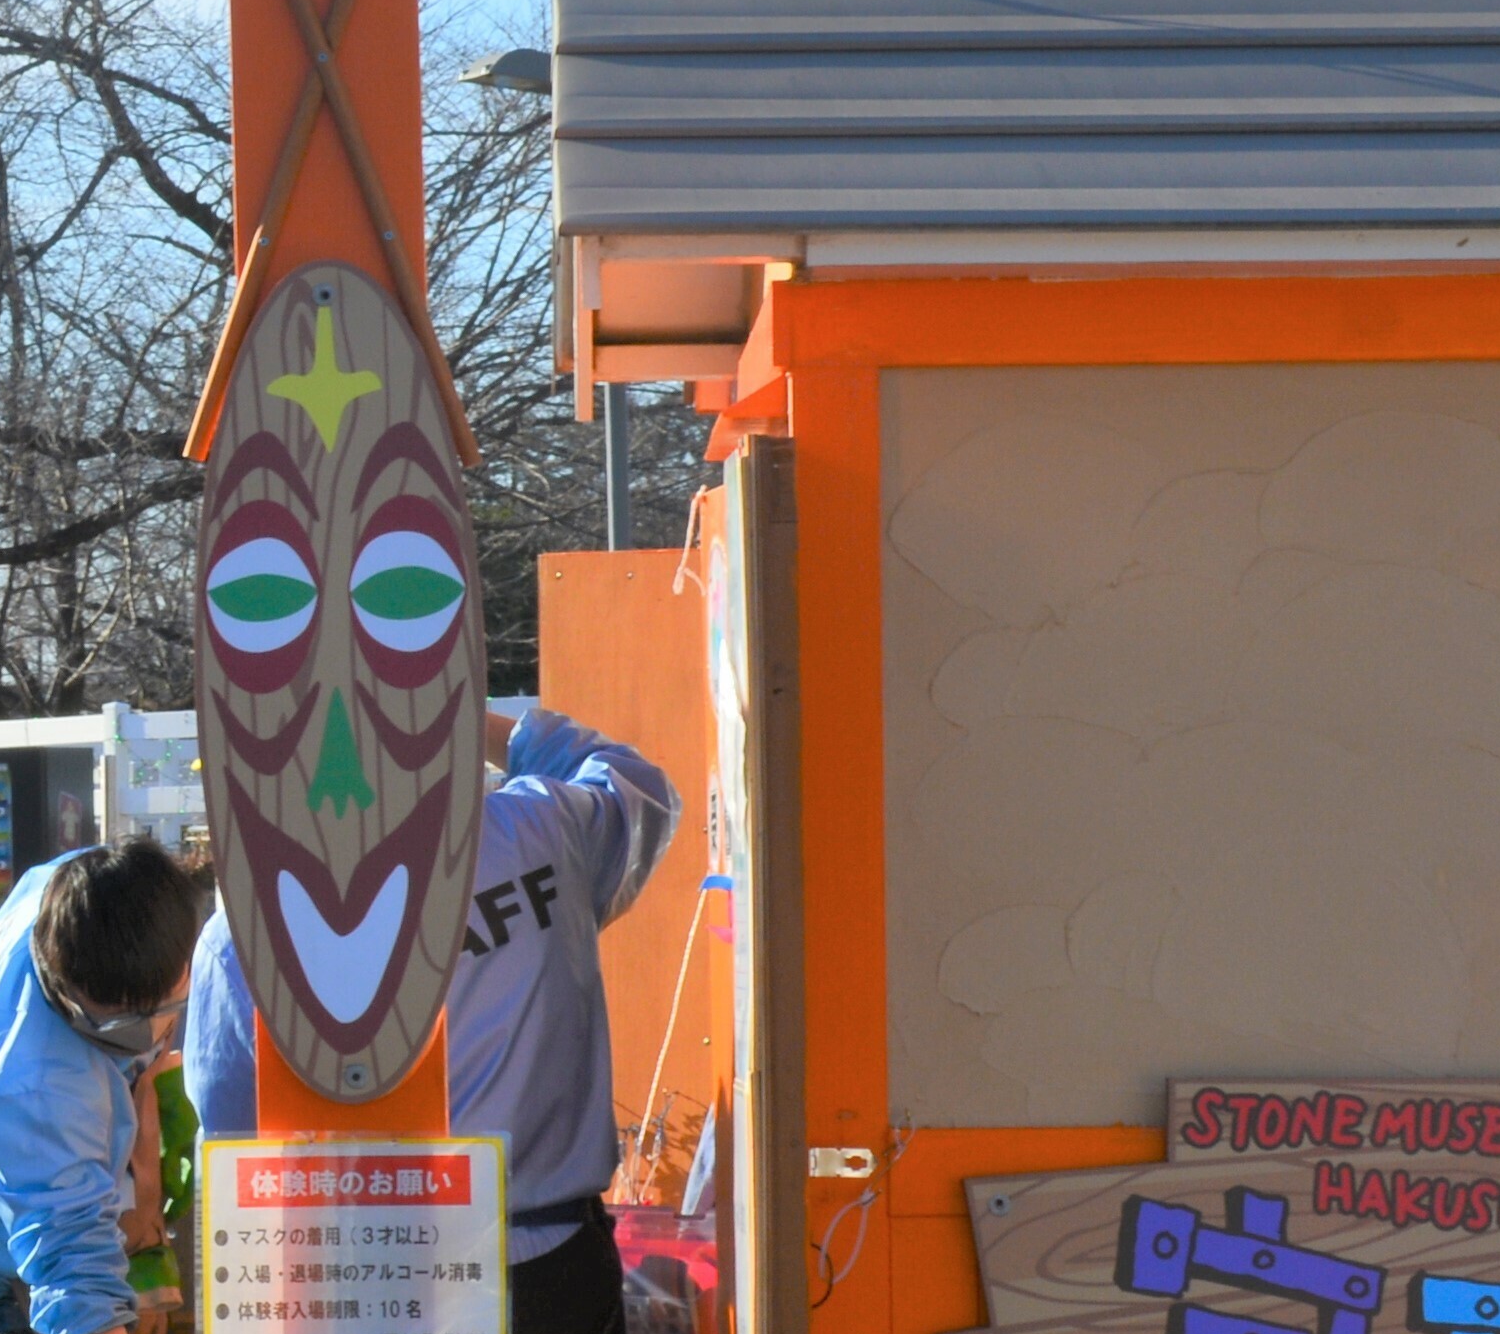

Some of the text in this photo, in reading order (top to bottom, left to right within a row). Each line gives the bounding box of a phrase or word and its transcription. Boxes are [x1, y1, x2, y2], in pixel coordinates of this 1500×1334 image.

[1181, 1086, 1367, 1152] STONE
[250, 1169, 452, 1199] 体験時のお願い
[237, 1225, 440, 1247] マスクの着用（3才以上）
[237, 1262, 483, 1284] 入場・退場時のアルコール消毒
